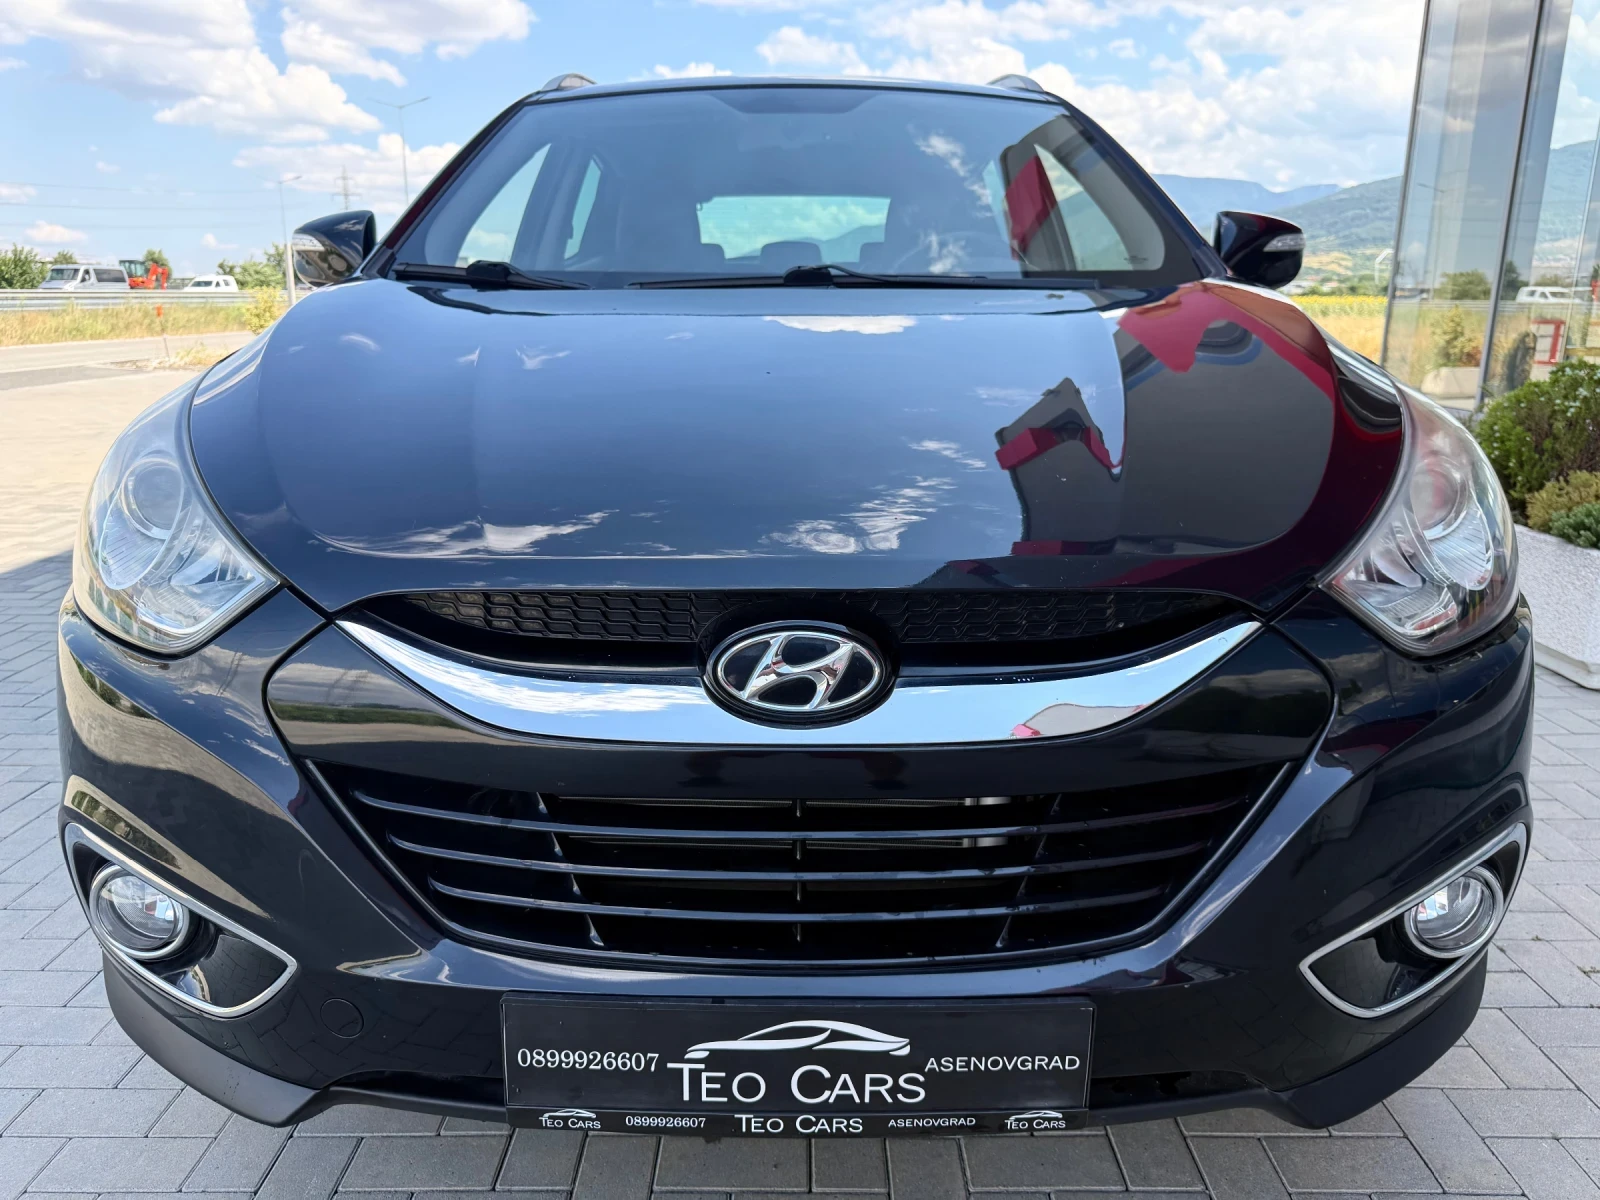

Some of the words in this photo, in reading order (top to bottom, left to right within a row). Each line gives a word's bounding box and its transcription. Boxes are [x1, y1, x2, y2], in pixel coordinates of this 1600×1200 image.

[517, 1048, 660, 1073] 0899926607
[924, 1055, 1081, 1073] ASENOVGRAD
[666, 1062, 767, 1103] TEO
[790, 1064, 927, 1104] CARS
[538, 1116, 564, 1129] TEO
[567, 1117, 602, 1130] CARS
[625, 1115, 707, 1129] 0899926607
[734, 1114, 785, 1134] TEO
[795, 1114, 864, 1134] CARS
[887, 1116, 977, 1129] ASENOVGRAD
[1004, 1119, 1029, 1130] TEO
[1033, 1118, 1067, 1130] CARS
